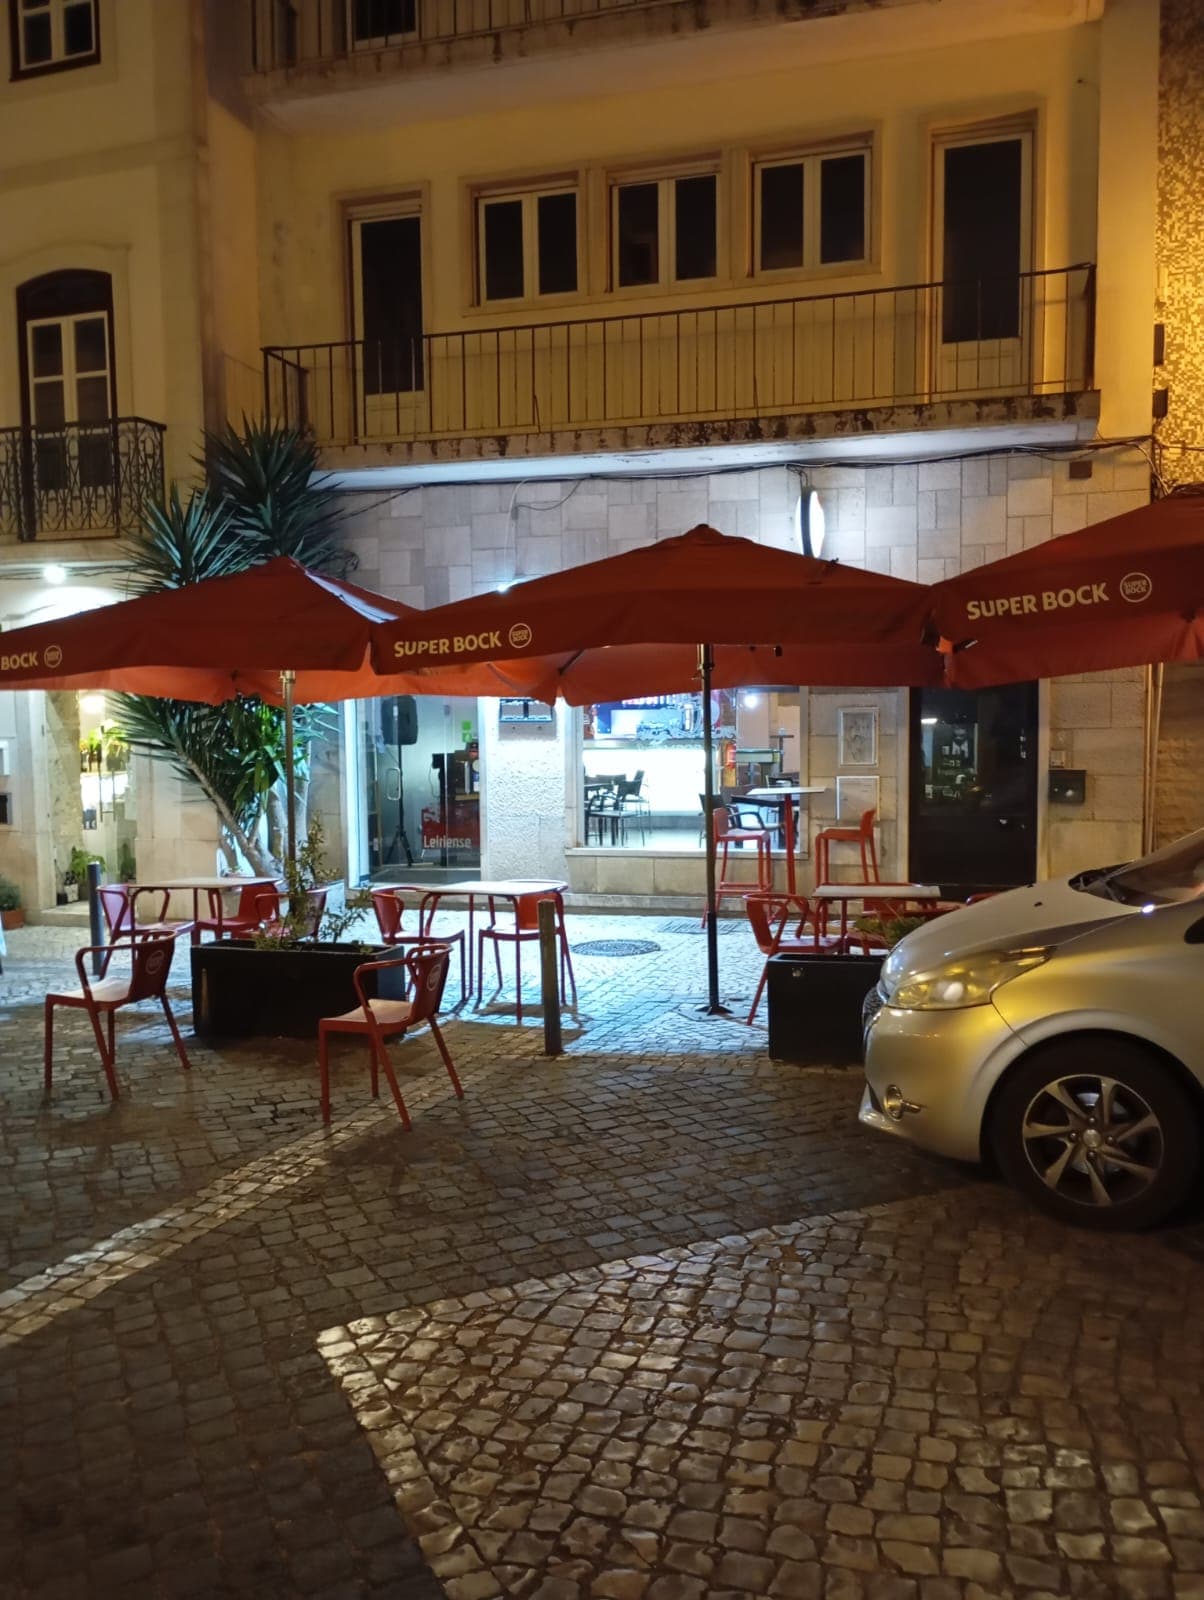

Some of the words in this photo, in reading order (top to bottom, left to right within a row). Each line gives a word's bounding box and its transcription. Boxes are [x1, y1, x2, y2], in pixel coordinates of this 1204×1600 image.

[966, 595, 1038, 620] SUPER
[1042, 582, 1110, 611] BOCK
[393, 638, 450, 658] SUPER
[453, 630, 502, 653] BOCK
[1, 651, 39, 670] BOCK
